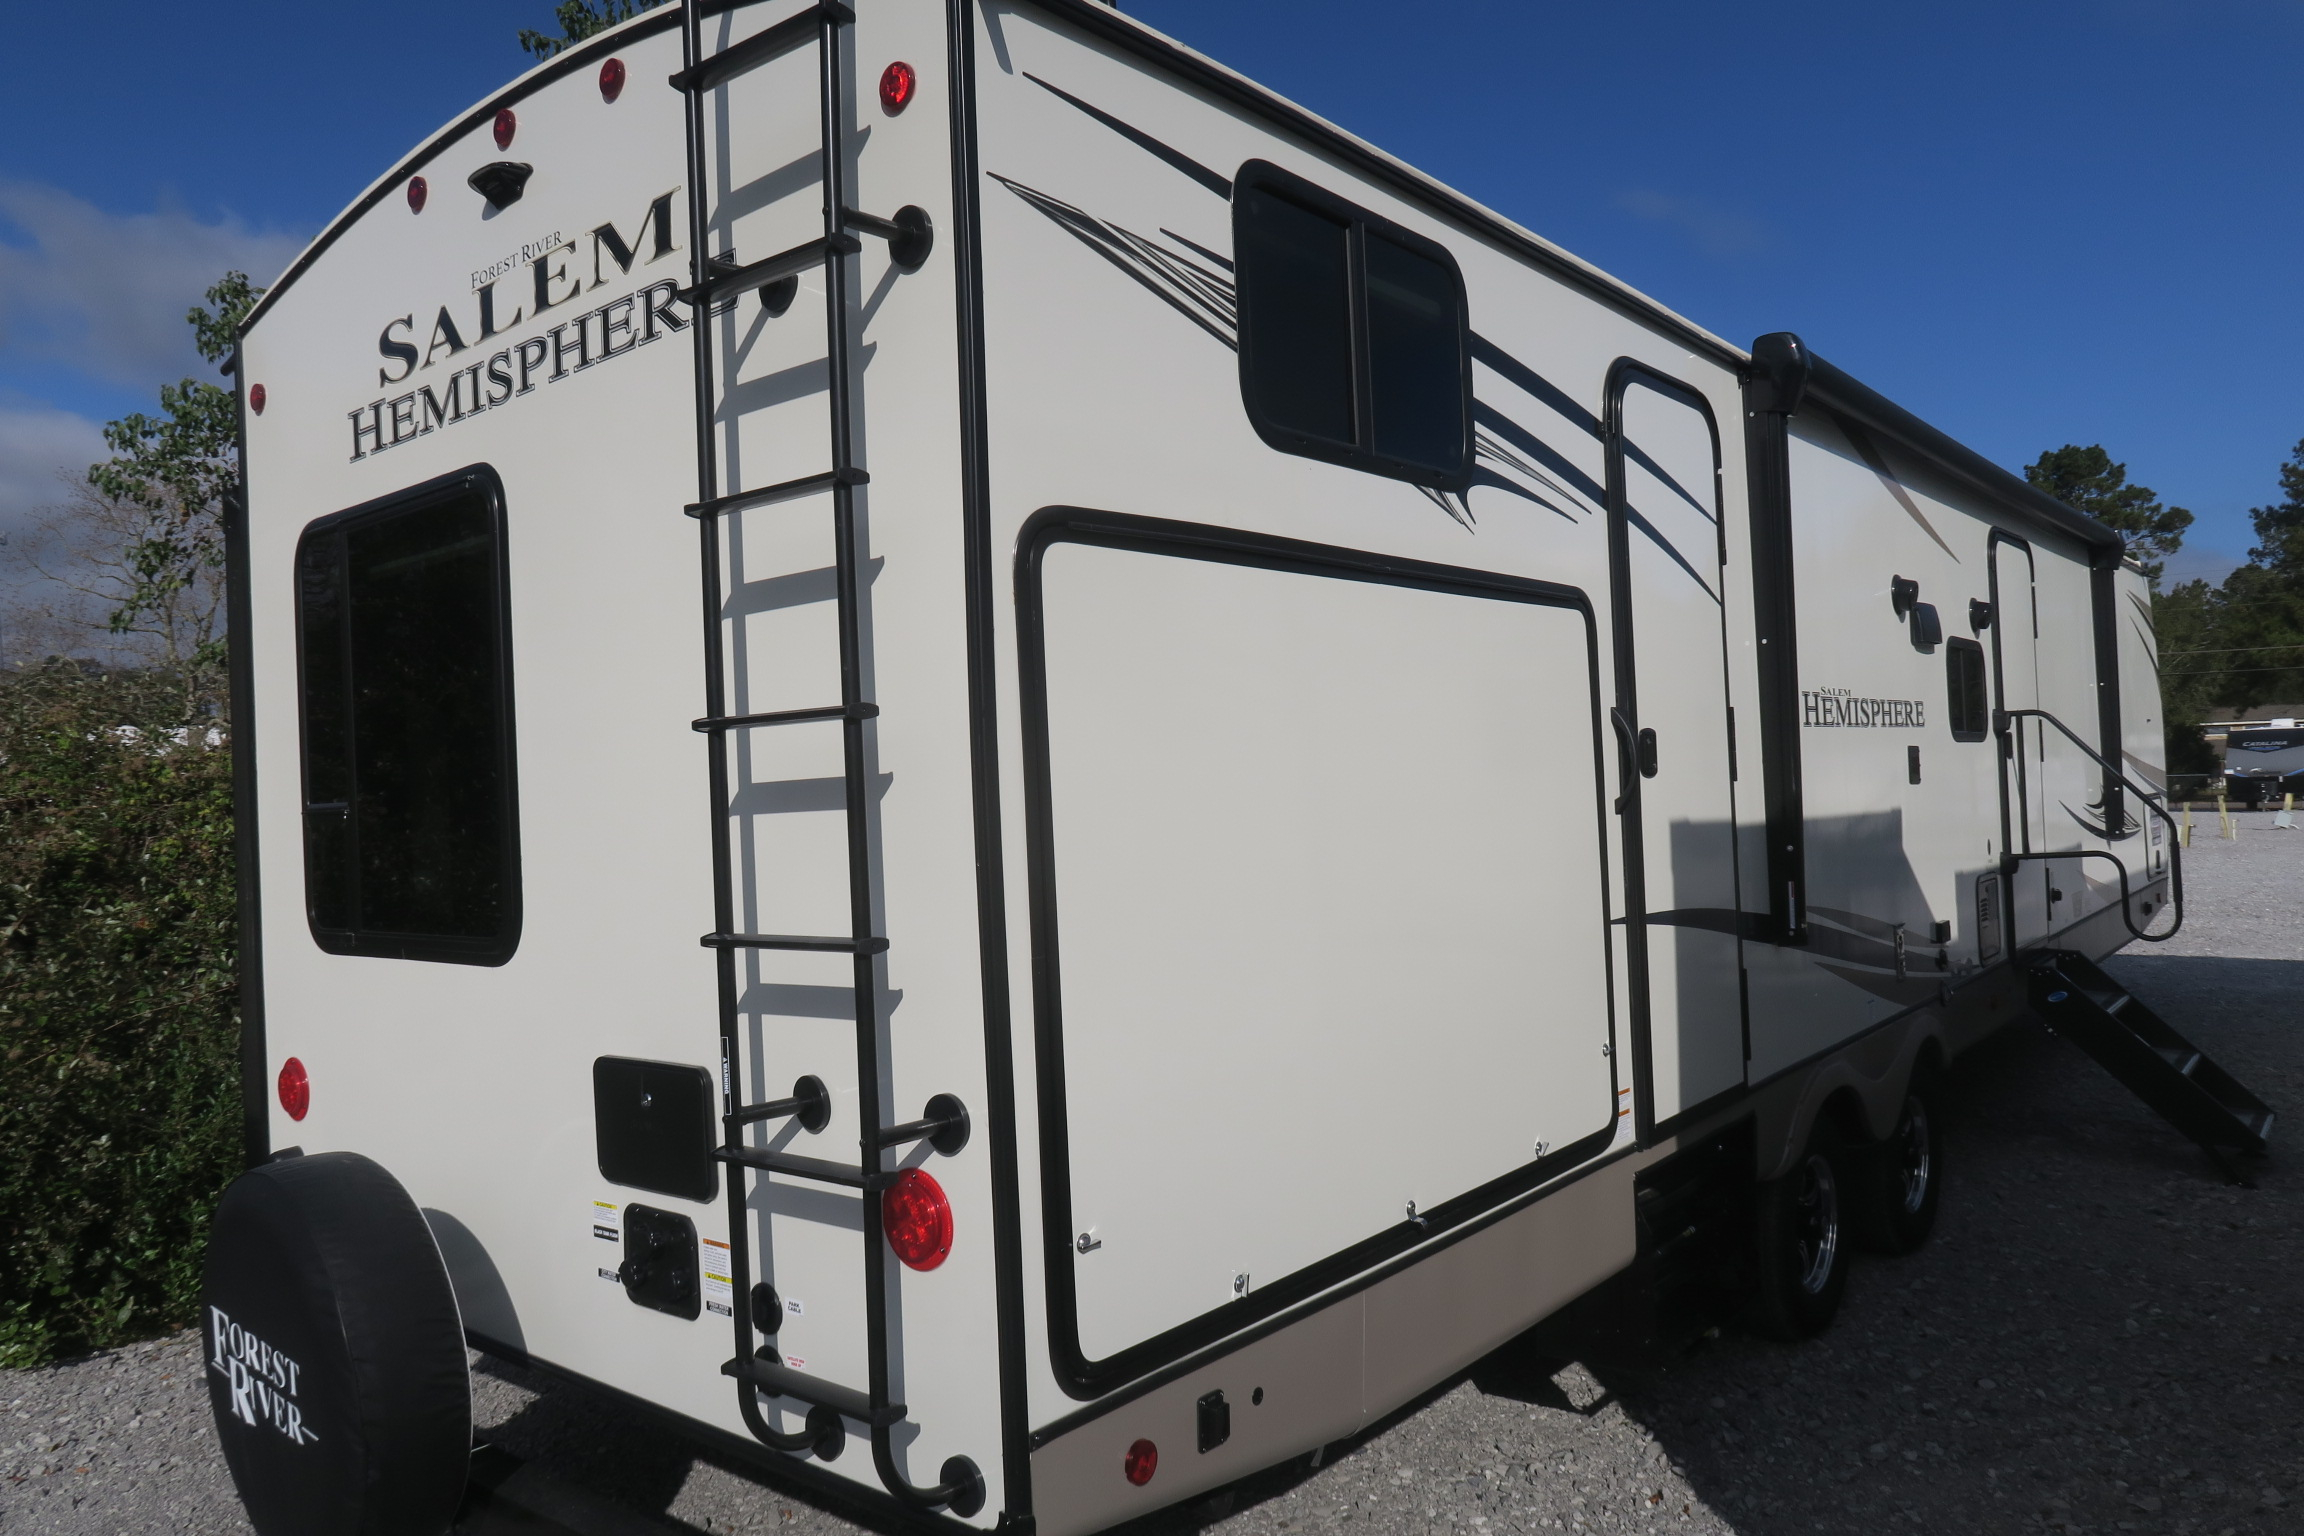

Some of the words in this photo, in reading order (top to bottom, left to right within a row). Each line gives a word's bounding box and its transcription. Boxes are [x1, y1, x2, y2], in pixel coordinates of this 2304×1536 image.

[378, 185, 683, 389] SALEM
[470, 252, 519, 289] FOREST
[521, 231, 563, 264] RIVER
[1802, 691, 1925, 728] HEMISPHERE
[1820, 686, 1851, 697] SALEM
[210, 1305, 300, 1397] FOREST
[227, 1355, 304, 1445] RIVER
